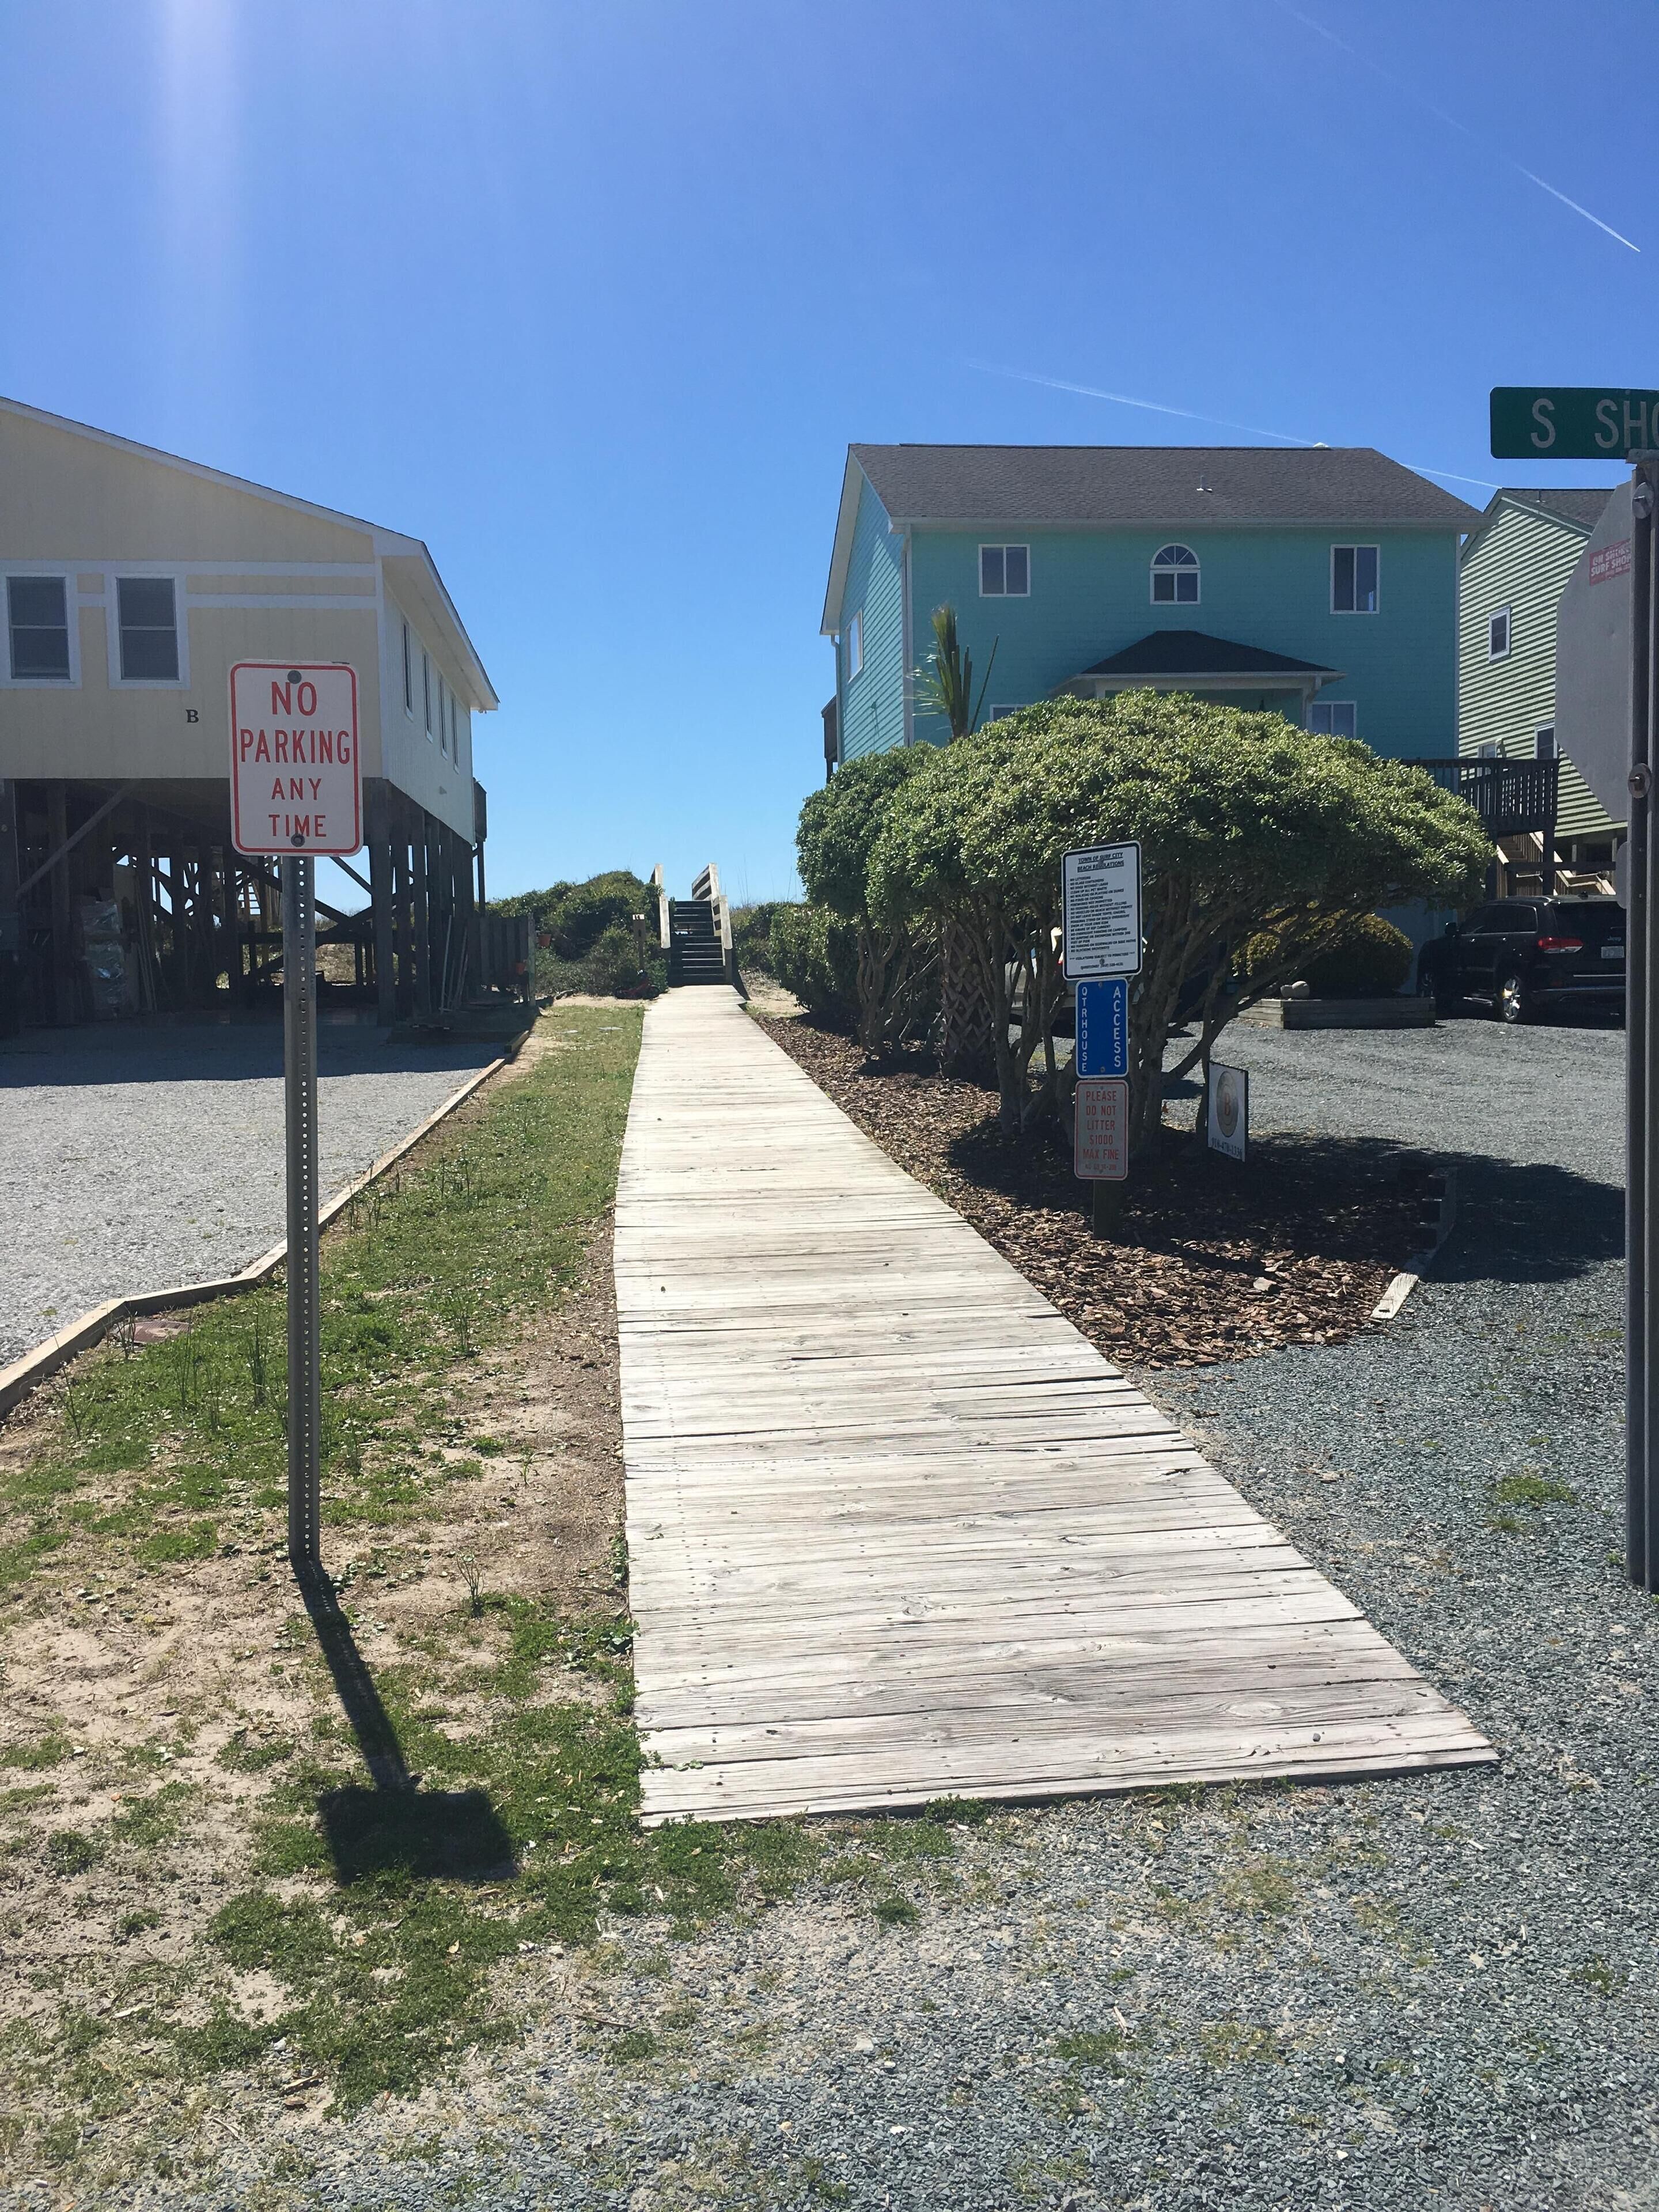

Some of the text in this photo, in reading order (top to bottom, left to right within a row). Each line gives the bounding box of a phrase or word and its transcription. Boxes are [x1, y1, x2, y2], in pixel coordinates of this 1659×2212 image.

[1531, 398, 1556, 448] S
[1591, 562, 1609, 577] SURF
[271, 681, 317, 716] NO
[185, 709, 199, 723] B
[240, 729, 350, 764] PARKING
[271, 778, 322, 800] ANY
[268, 815, 327, 837] TIME
[1113, 986, 1121, 1067] ACCESS
[1086, 1090, 1117, 1101] PLEASE
[1086, 1105, 1116, 1116] DO NOT
[1087, 1120, 1115, 1131] LITTER
[1089, 1134, 1113, 1146] $1000
[1083, 1149, 1119, 1160] MAX FINE
